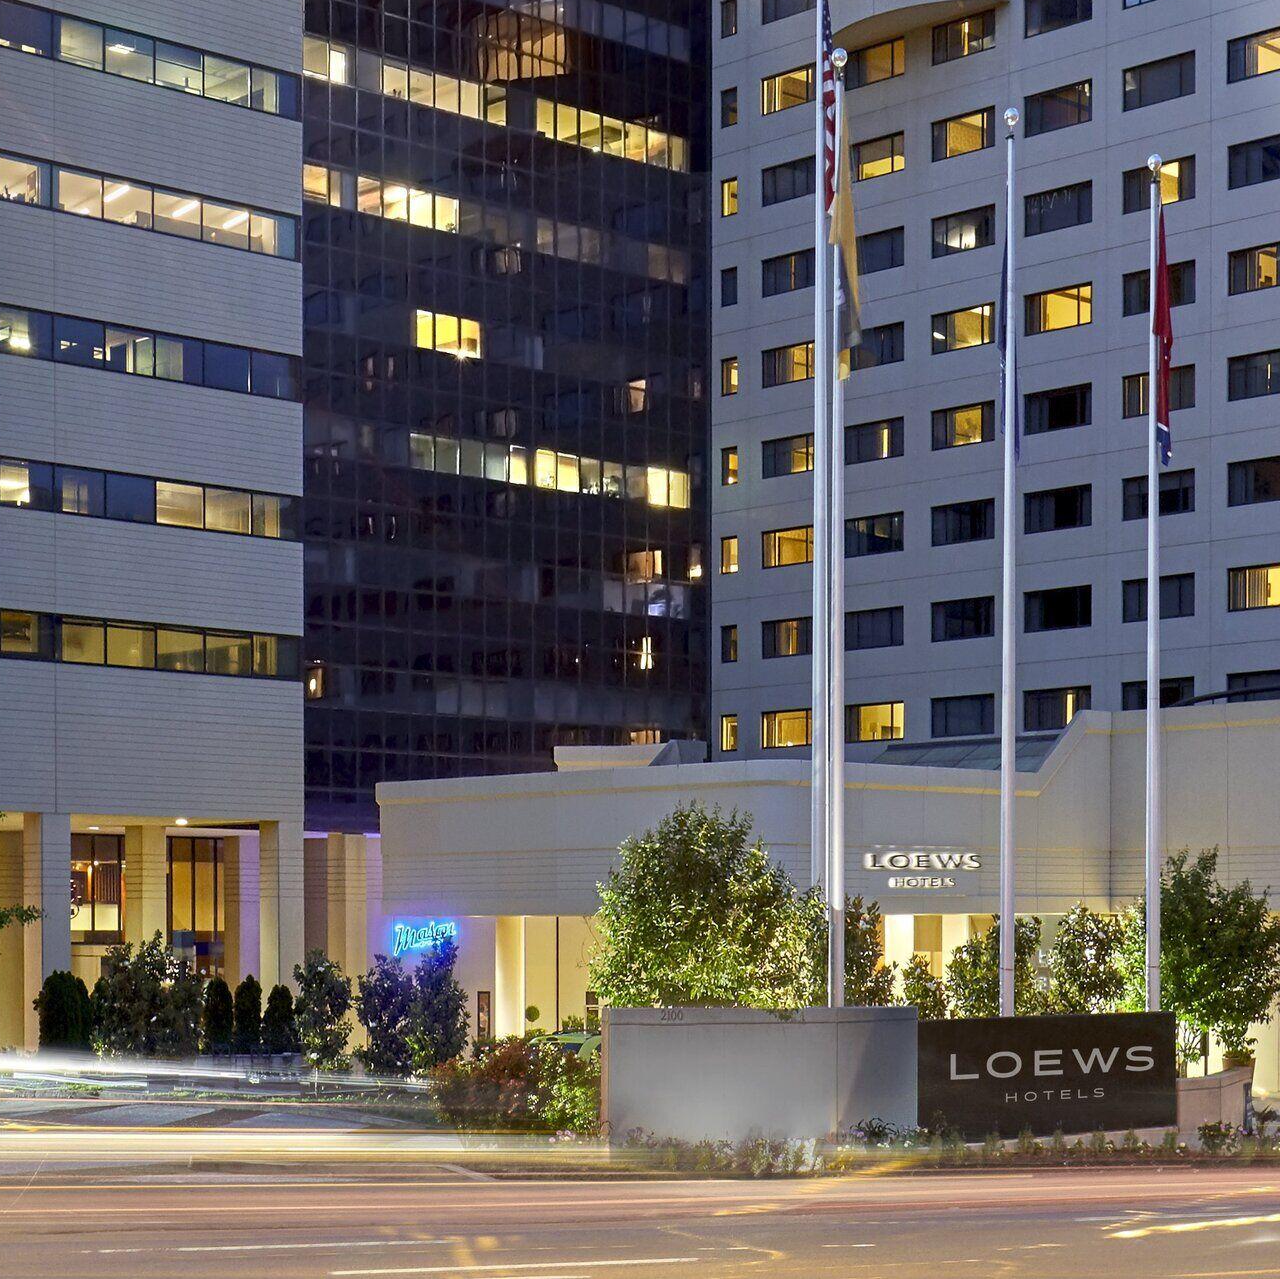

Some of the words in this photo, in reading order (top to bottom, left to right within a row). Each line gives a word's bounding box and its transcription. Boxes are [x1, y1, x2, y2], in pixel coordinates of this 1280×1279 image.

[865, 852, 983, 870] LOEWS
[890, 876, 958, 888] HOTELS
[660, 1009, 684, 1021] 2100
[949, 1045, 1156, 1081] LOEWS
[1005, 1087, 1106, 1103] HOTELS
